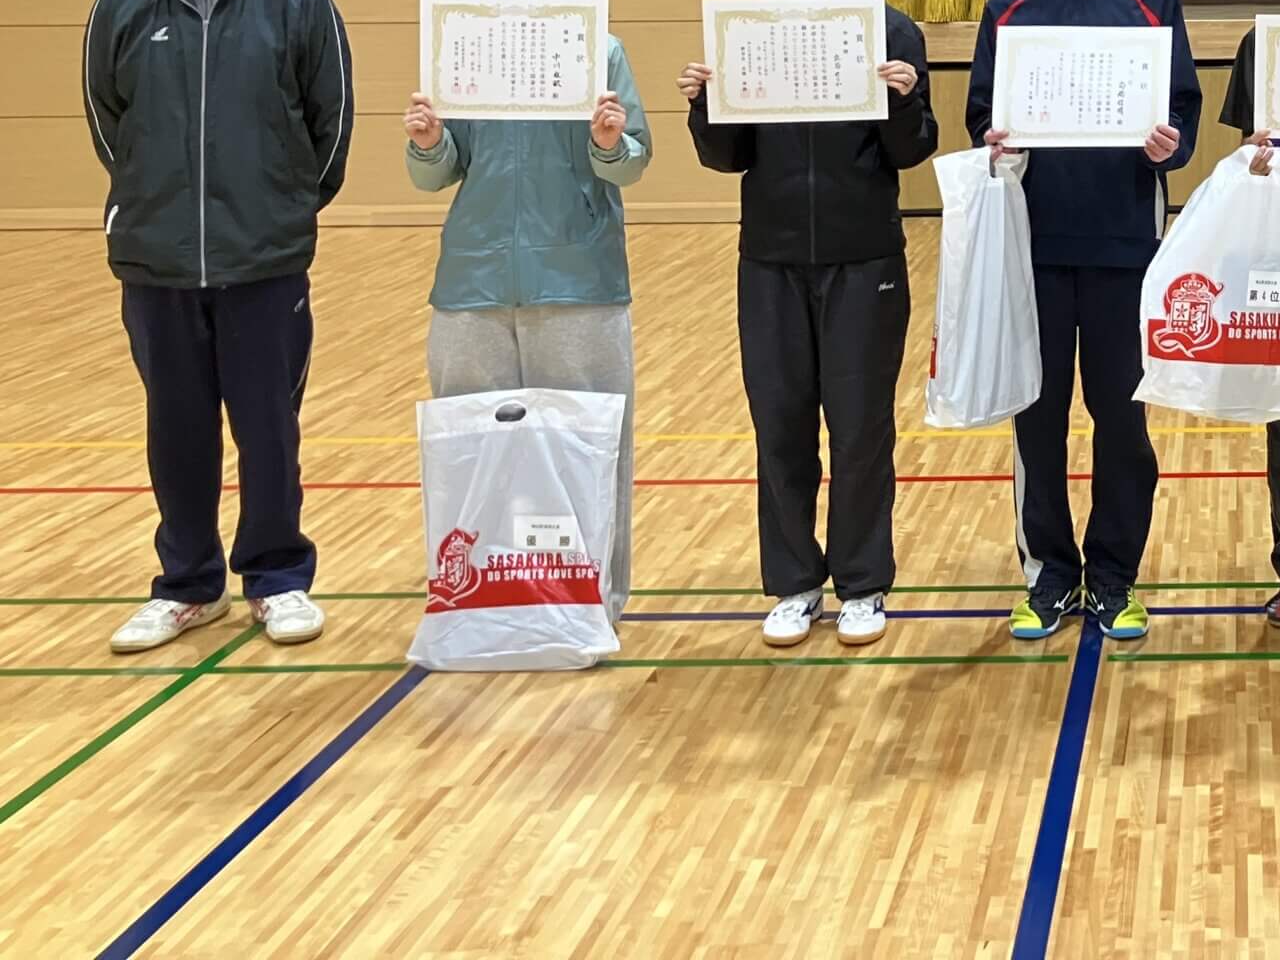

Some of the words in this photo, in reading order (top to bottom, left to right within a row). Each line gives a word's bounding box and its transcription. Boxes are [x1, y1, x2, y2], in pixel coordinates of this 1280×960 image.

[1228, 327, 1241, 339] DO
[1244, 328, 1277, 340] SPORTS
[487, 552, 564, 570] SASAKURA
[487, 570, 501, 582] DO
[503, 568, 545, 581] SPORTS
[548, 567, 573, 580] LOVE
